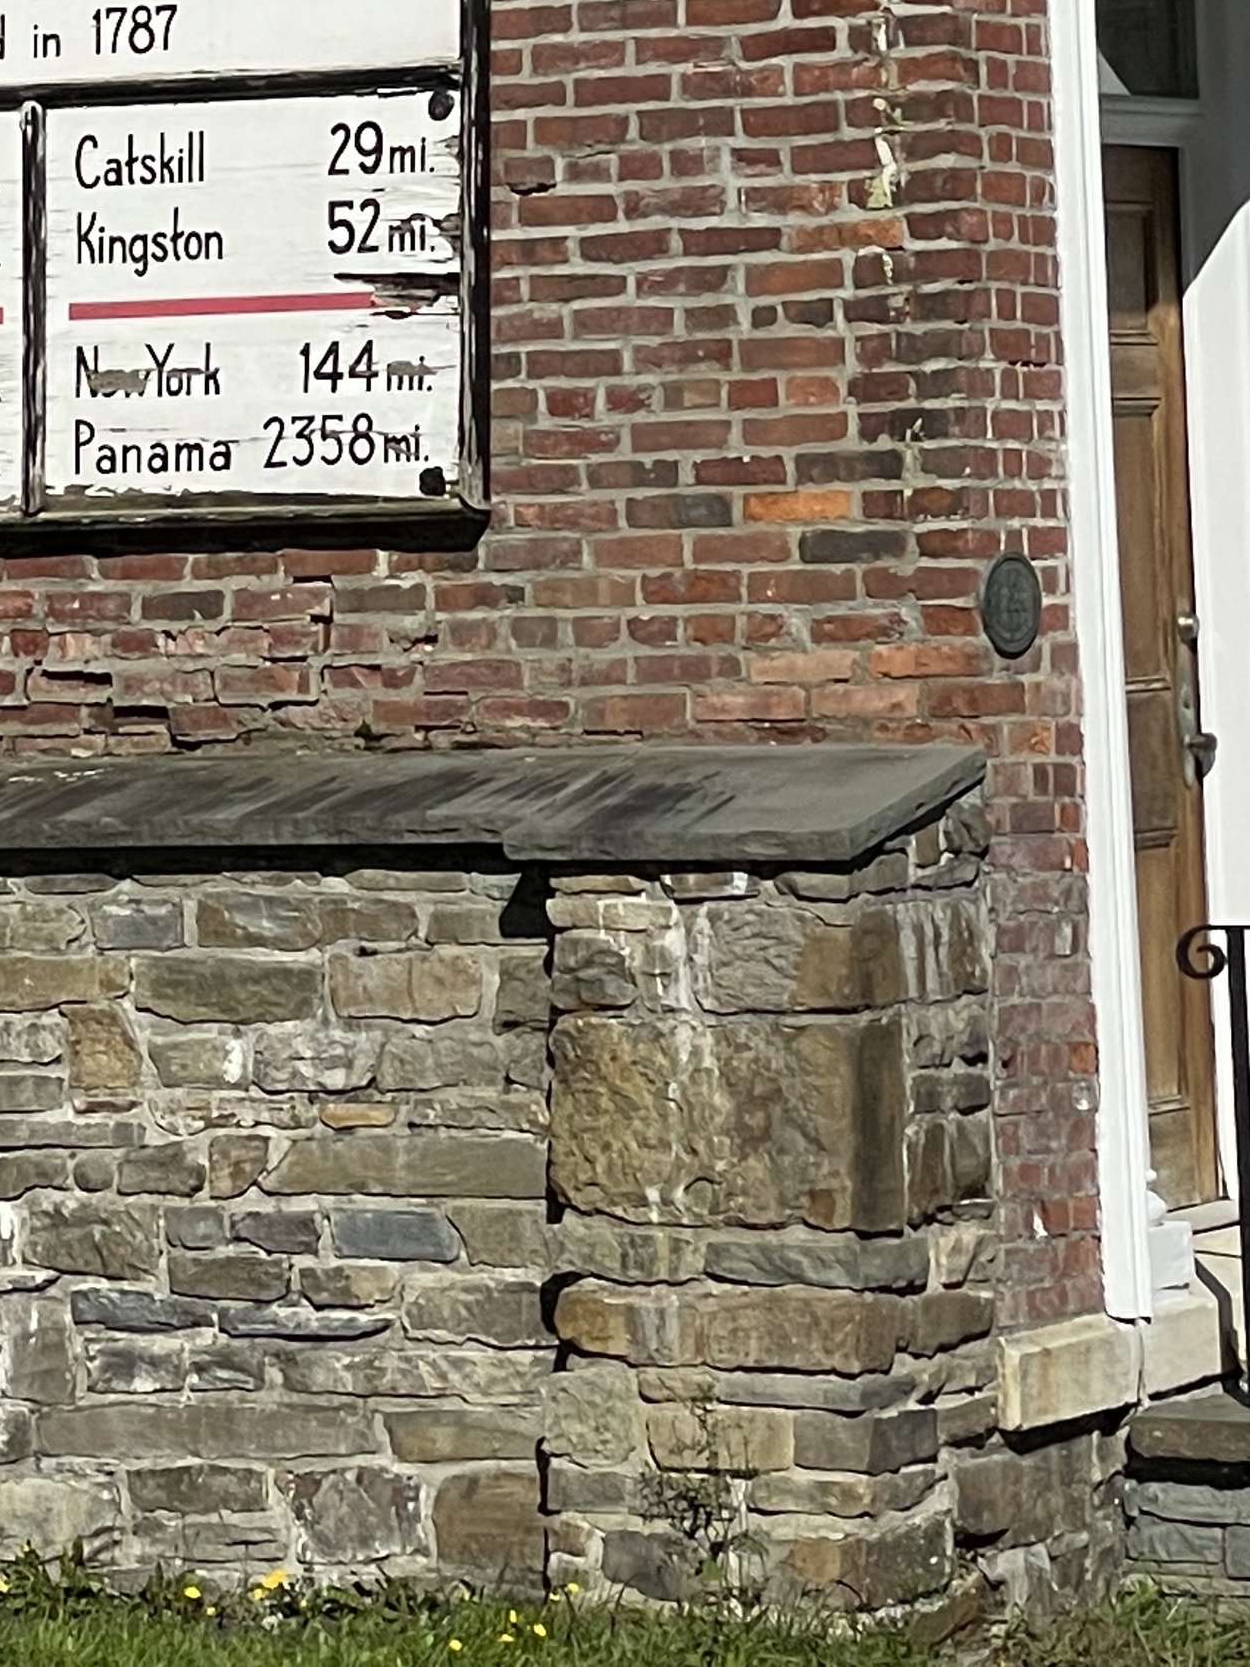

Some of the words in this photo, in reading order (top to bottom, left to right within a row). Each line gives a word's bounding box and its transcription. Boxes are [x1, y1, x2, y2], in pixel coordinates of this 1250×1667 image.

[32, 24, 61, 58] in
[92, 3, 178, 55] 1787
[74, 130, 205, 190] Catskill
[75, 206, 224, 277] Kingston
[74, 418, 234, 475] Panama
